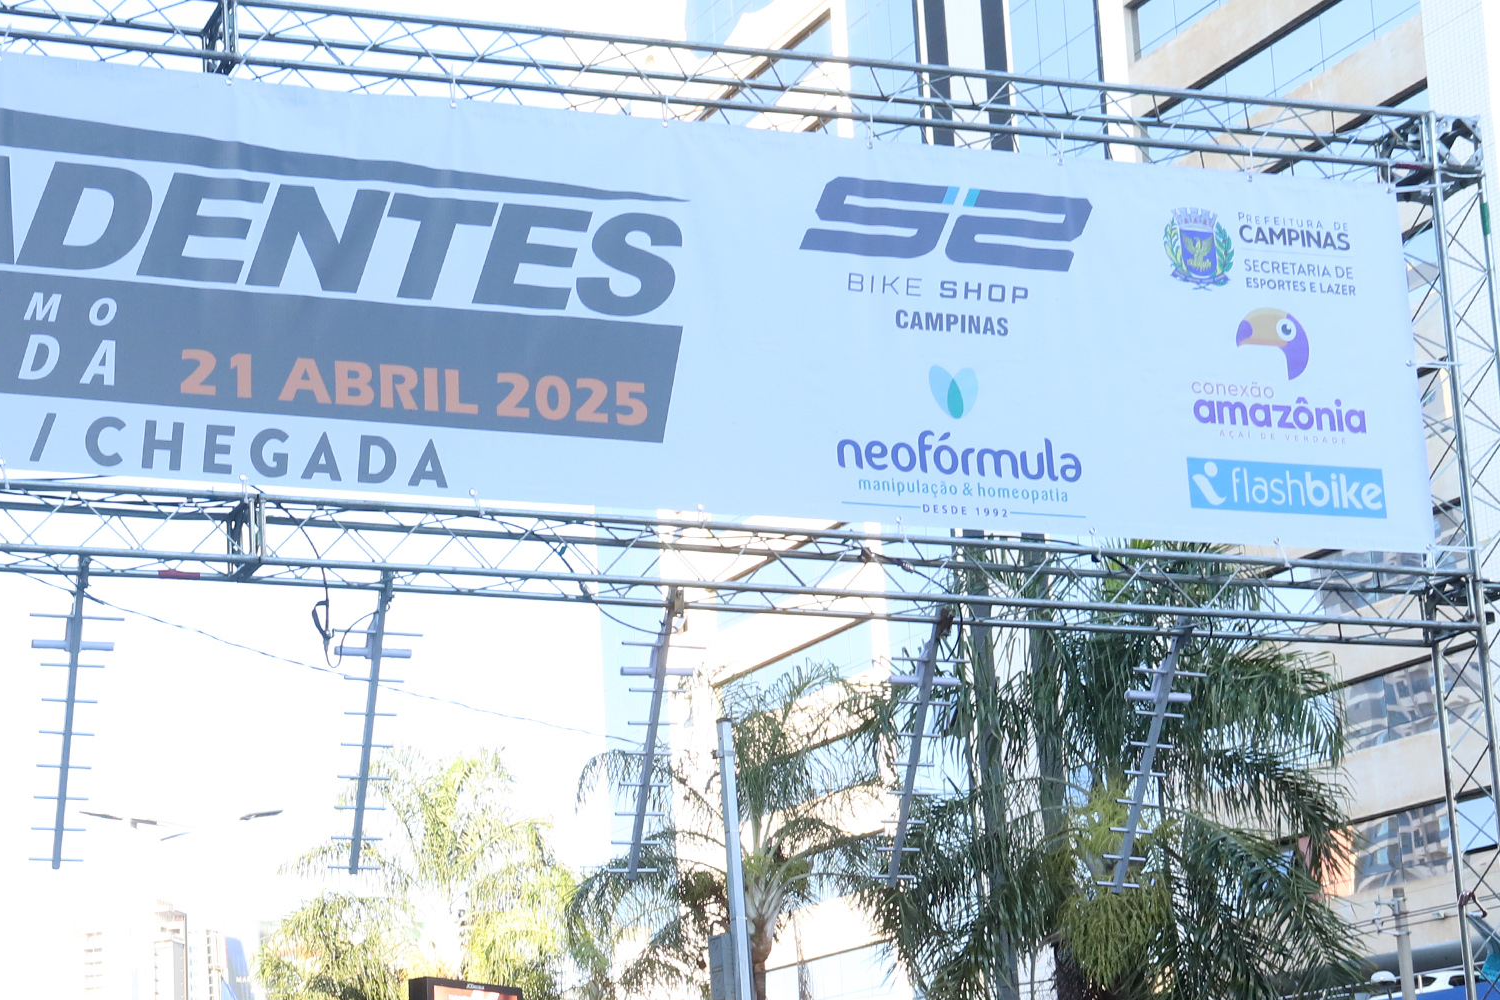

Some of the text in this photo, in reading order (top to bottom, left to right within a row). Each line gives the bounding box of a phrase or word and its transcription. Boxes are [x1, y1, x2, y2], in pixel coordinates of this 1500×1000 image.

[1238, 212, 1348, 232] PREFEITURA DE
[1238, 225, 1350, 251] CAMPINAS
[1244, 259, 1354, 280] SECRETARIA DE
[848, 272, 1029, 304] BIKE SHOP
[1246, 277, 1356, 296] ESPORTES E LAZER
[895, 309, 1009, 336] CAMPINAS
[180, 349, 649, 426] 21 ABRIL 2025
[1191, 381, 1274, 399] conexão
[1193, 397, 1367, 434] amazônia
[29, 412, 56, 463] /
[85, 416, 448, 489] CHEGADA
[1260, 432, 1275, 440] DE
[1285, 434, 1346, 445] VERDADE
[837, 430, 1082, 483] neofórmula
[858, 478, 1068, 504] manipulação & homeopatia
[1232, 467, 1383, 511] flashbike
[922, 504, 1008, 518] DESDE 1992
